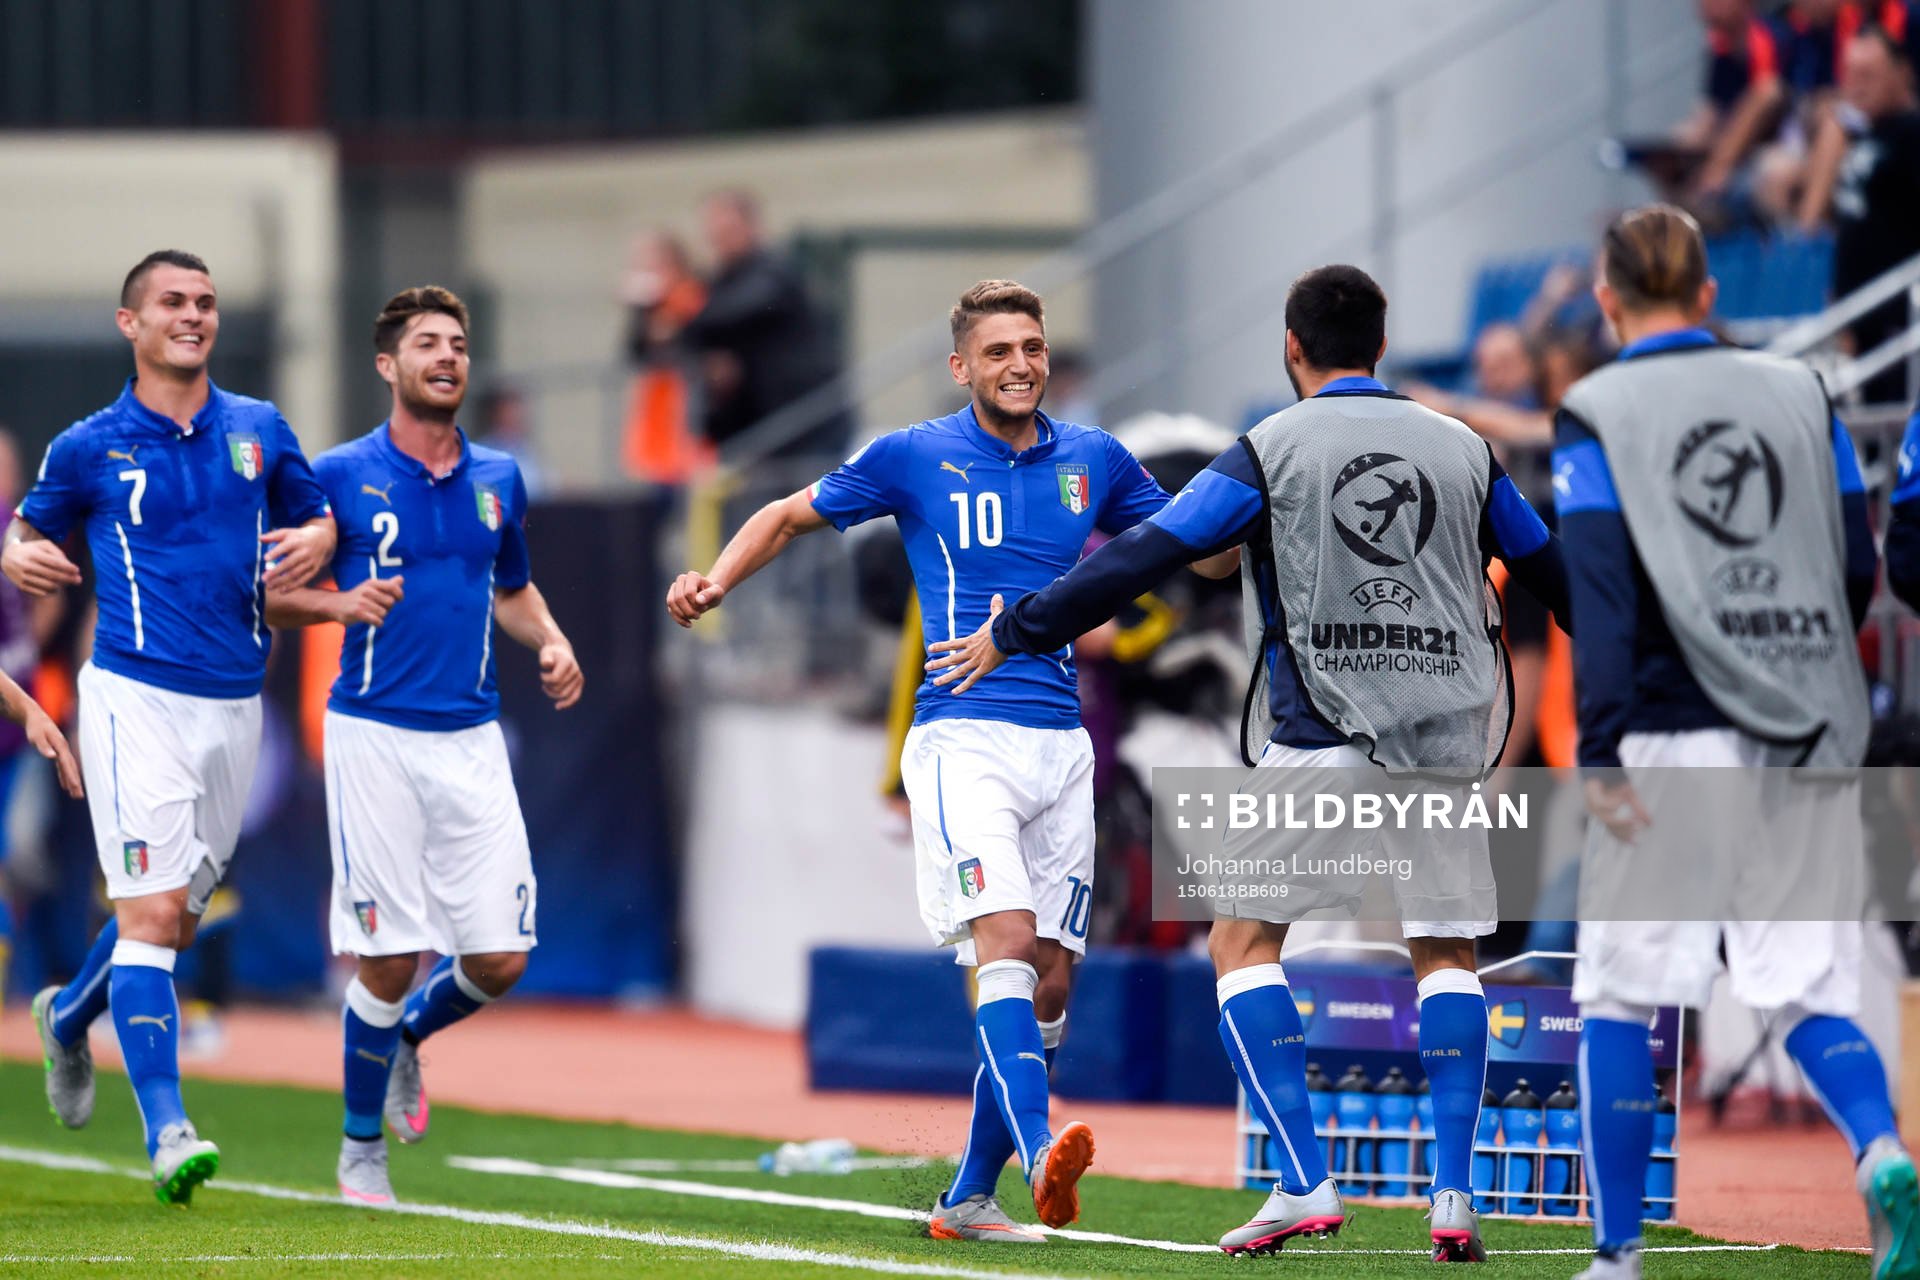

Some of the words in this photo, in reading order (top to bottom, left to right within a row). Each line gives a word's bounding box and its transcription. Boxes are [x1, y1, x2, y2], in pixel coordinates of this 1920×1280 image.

[1059, 465, 1085, 474] ITALIA
[118, 468, 147, 526] 7
[950, 491, 1003, 549] 10
[372, 511, 403, 567] 2
[1354, 583, 1414, 611] UEFA
[1311, 623, 1458, 656] UNDER21
[1314, 653, 1460, 677] CHAMPIONSHIP
[516, 883, 532, 936] 2
[1060, 875, 1092, 939] 10
[1327, 1001, 1394, 1020] SWEDEN
[1423, 1048, 1461, 1058] ITALIA
